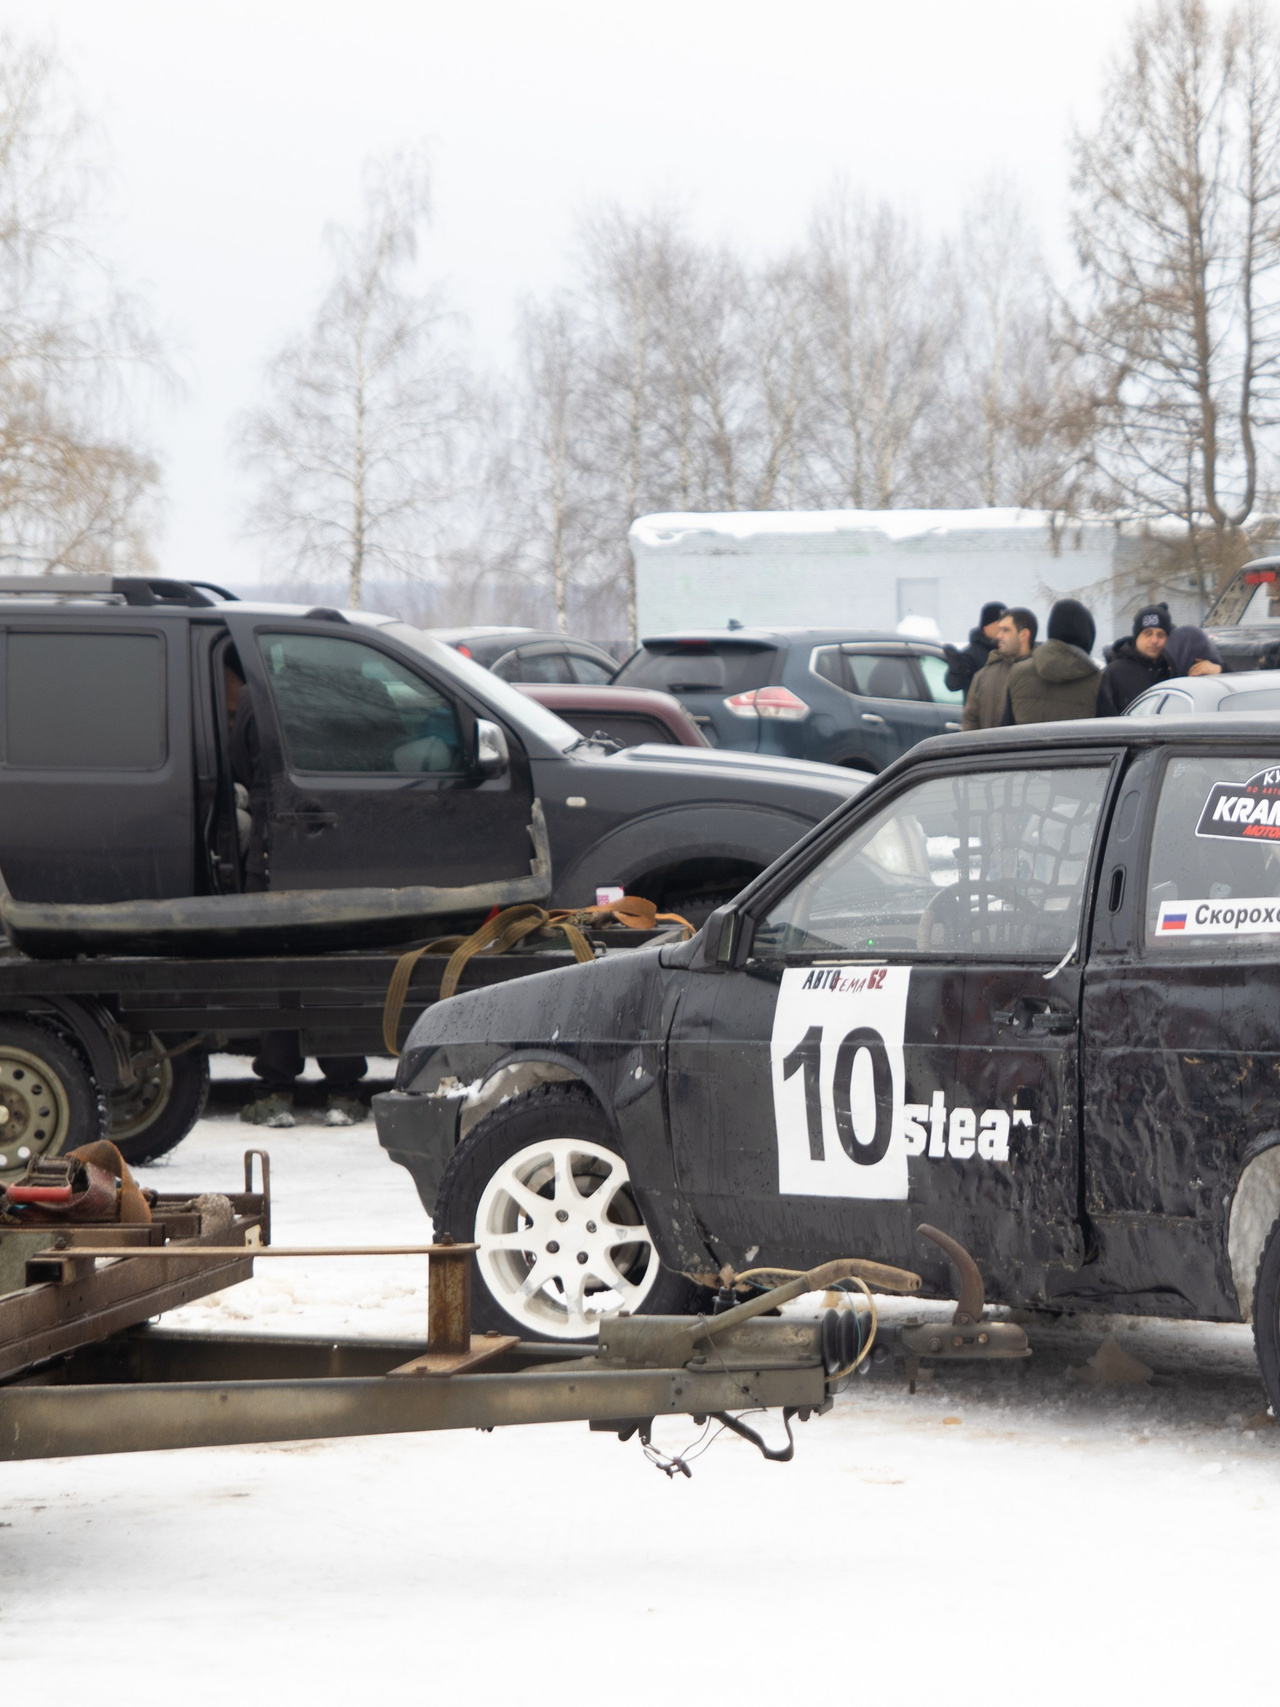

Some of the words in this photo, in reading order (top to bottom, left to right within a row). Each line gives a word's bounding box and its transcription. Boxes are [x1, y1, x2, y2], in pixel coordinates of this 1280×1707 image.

[1246, 785, 1259, 794] ПО
[867, 968, 888, 990] 62
[783, 1025, 894, 1166] 10
[904, 1090, 1034, 1162] stea
